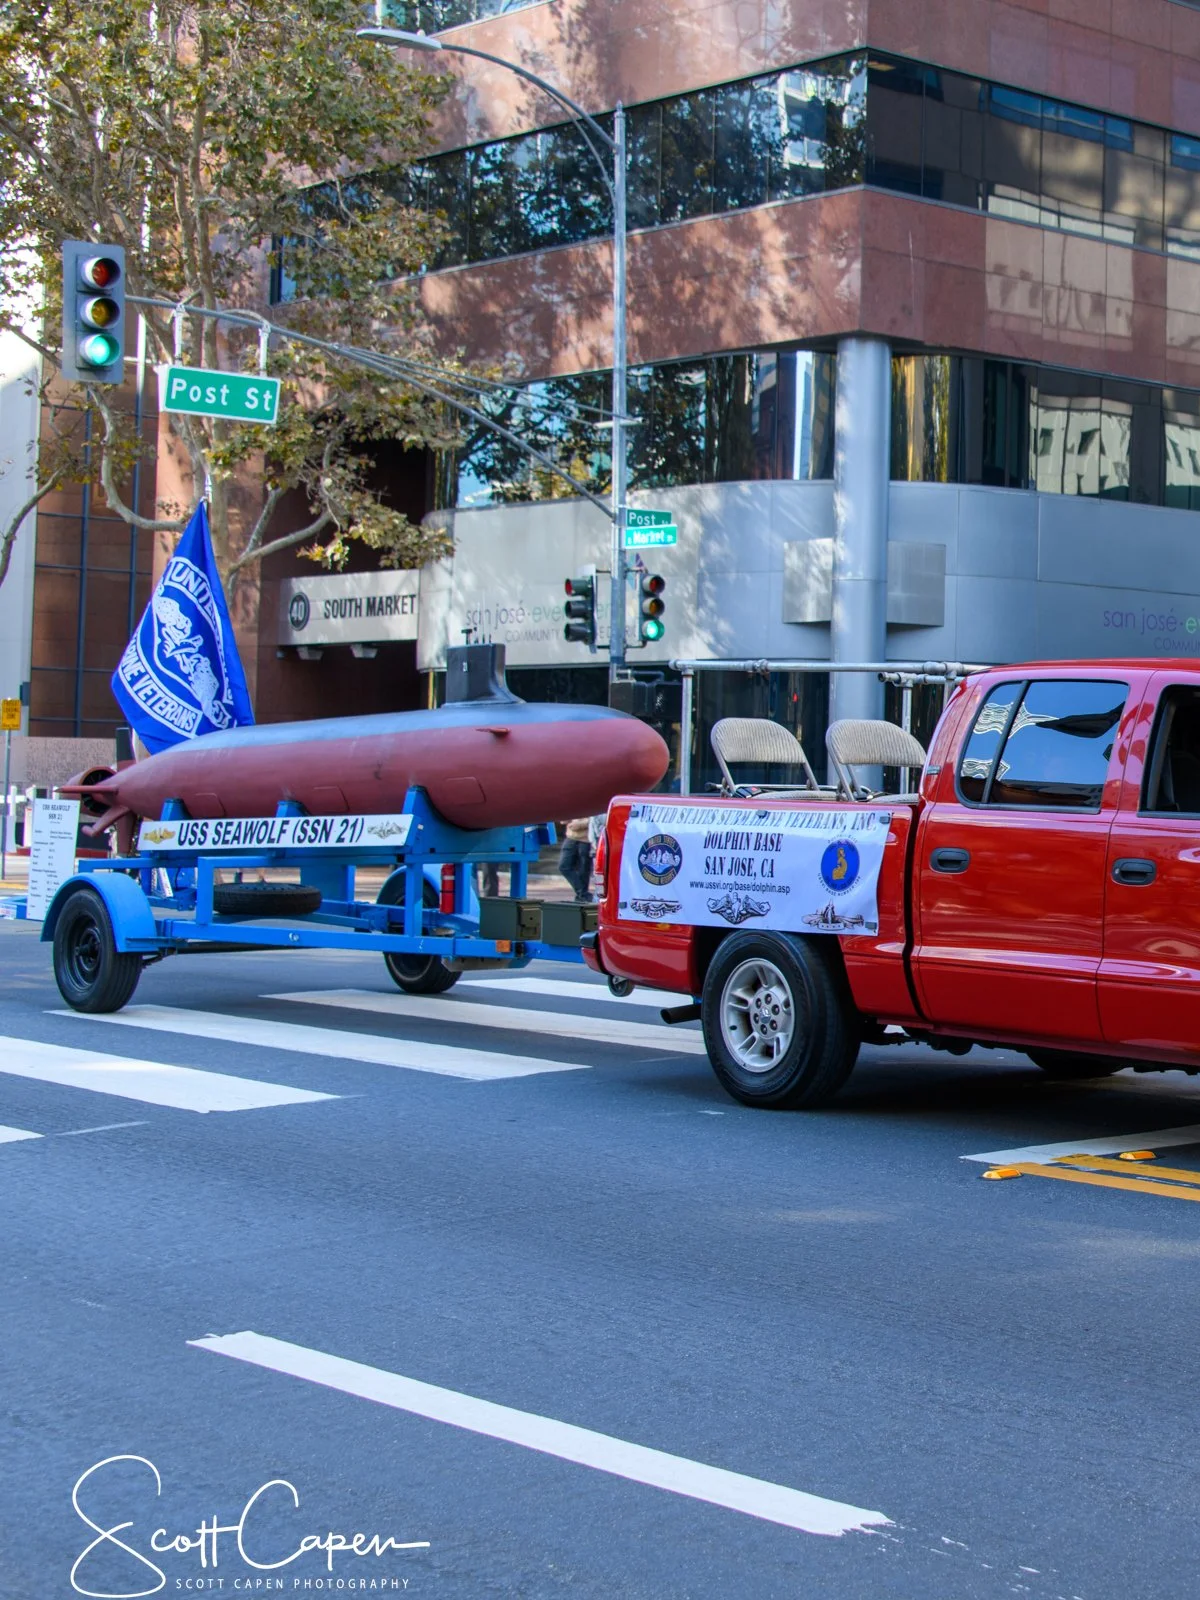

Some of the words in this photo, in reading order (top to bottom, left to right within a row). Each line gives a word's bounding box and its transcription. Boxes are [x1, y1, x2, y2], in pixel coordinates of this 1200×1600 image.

[171, 378, 230, 406] Post
[244, 387, 272, 412] St
[629, 512, 656, 526] Post
[633, 529, 665, 544] Market
[291, 600, 305, 620] 40
[324, 598, 362, 619] SOUTH
[366, 595, 417, 617] MARKET
[466, 607, 491, 626] san
[1103, 609, 1136, 629] san
[132, 673, 197, 732] VETERANS
[640, 805, 678, 824] UNITED
[677, 807, 720, 825] STATES
[785, 811, 848, 832] VETERANS,
[850, 812, 877, 831] INC.
[178, 822, 207, 846] USS
[212, 819, 290, 846] SEAWOLF
[292, 818, 334, 845] (SSN
[336, 817, 365, 844] 21)
[703, 830, 752, 851] DOLPHIN
[754, 832, 783, 852] BASE
[704, 856, 726, 875] SAN
[727, 857, 757, 880] JOSE,
[761, 858, 774, 878] CA
[690, 881, 791, 895] www.ussvi.org/base/dolphin.asp
